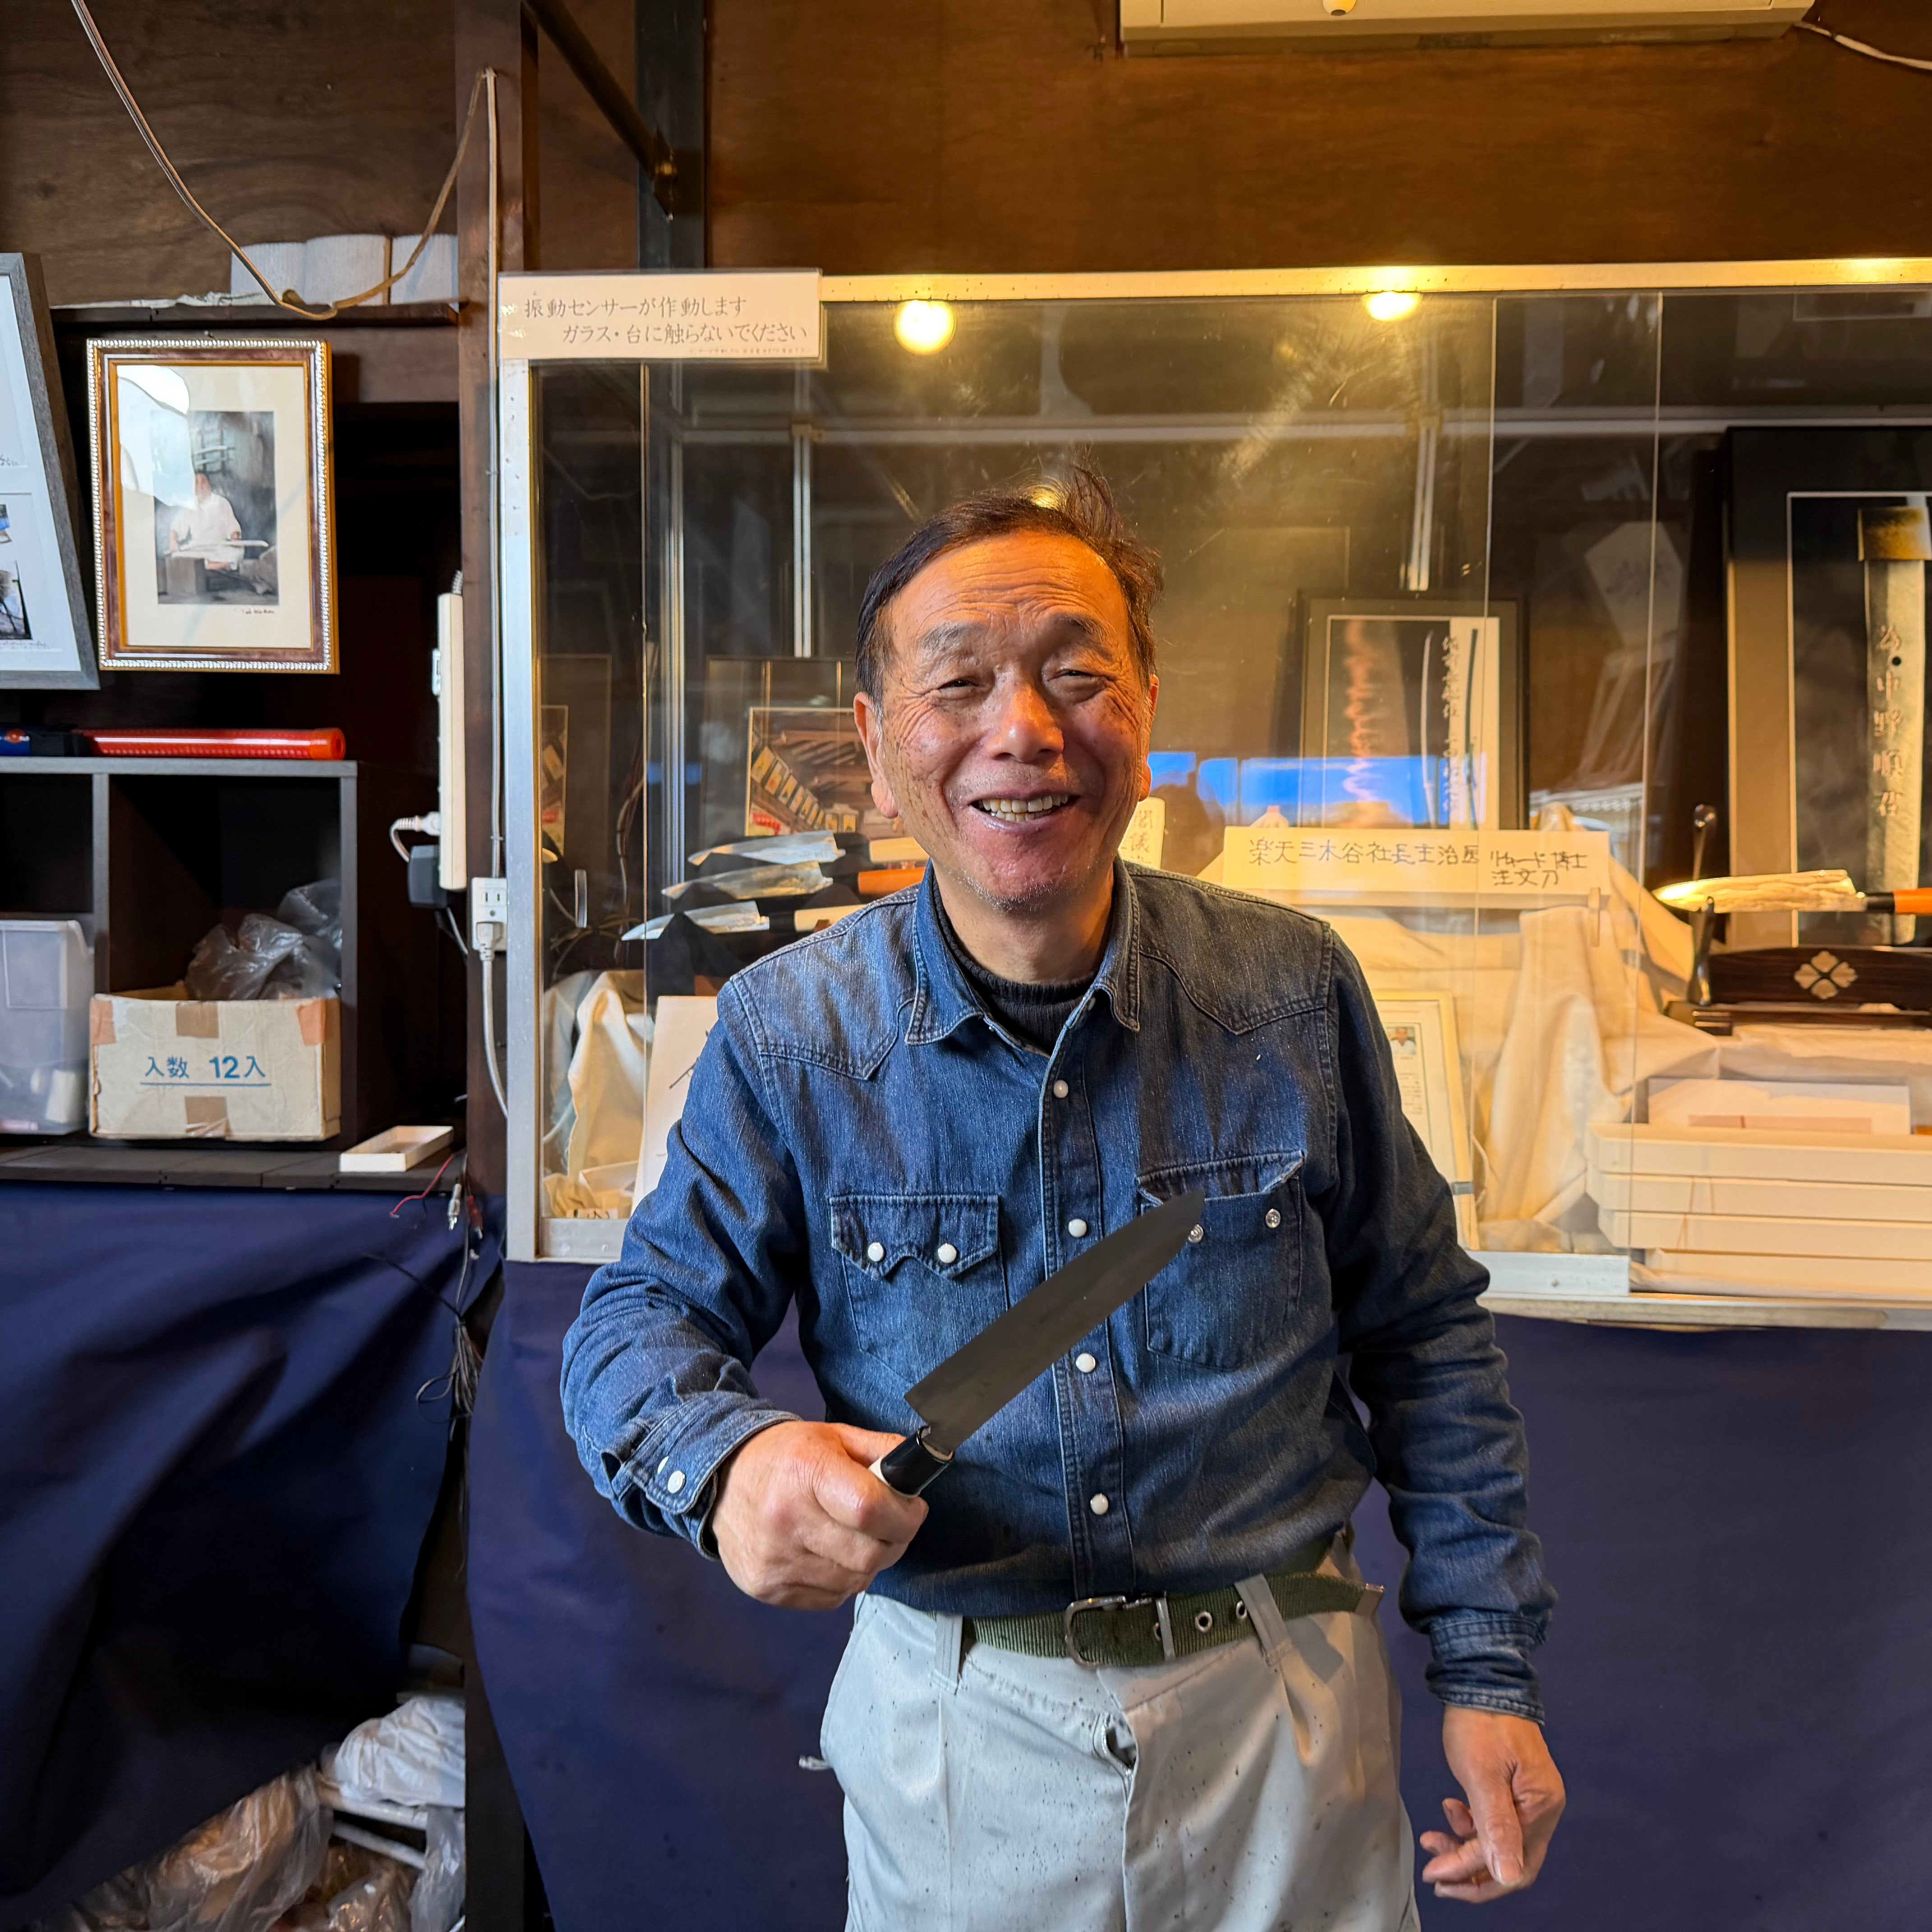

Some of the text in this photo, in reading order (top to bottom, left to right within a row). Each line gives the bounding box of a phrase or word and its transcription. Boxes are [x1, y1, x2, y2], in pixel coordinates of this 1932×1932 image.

[524, 295, 747, 317] 振動センサーが作動します
[563, 323, 807, 345] ガラス・台に触らないでください
[145, 1055, 266, 1079] 入数 12入
